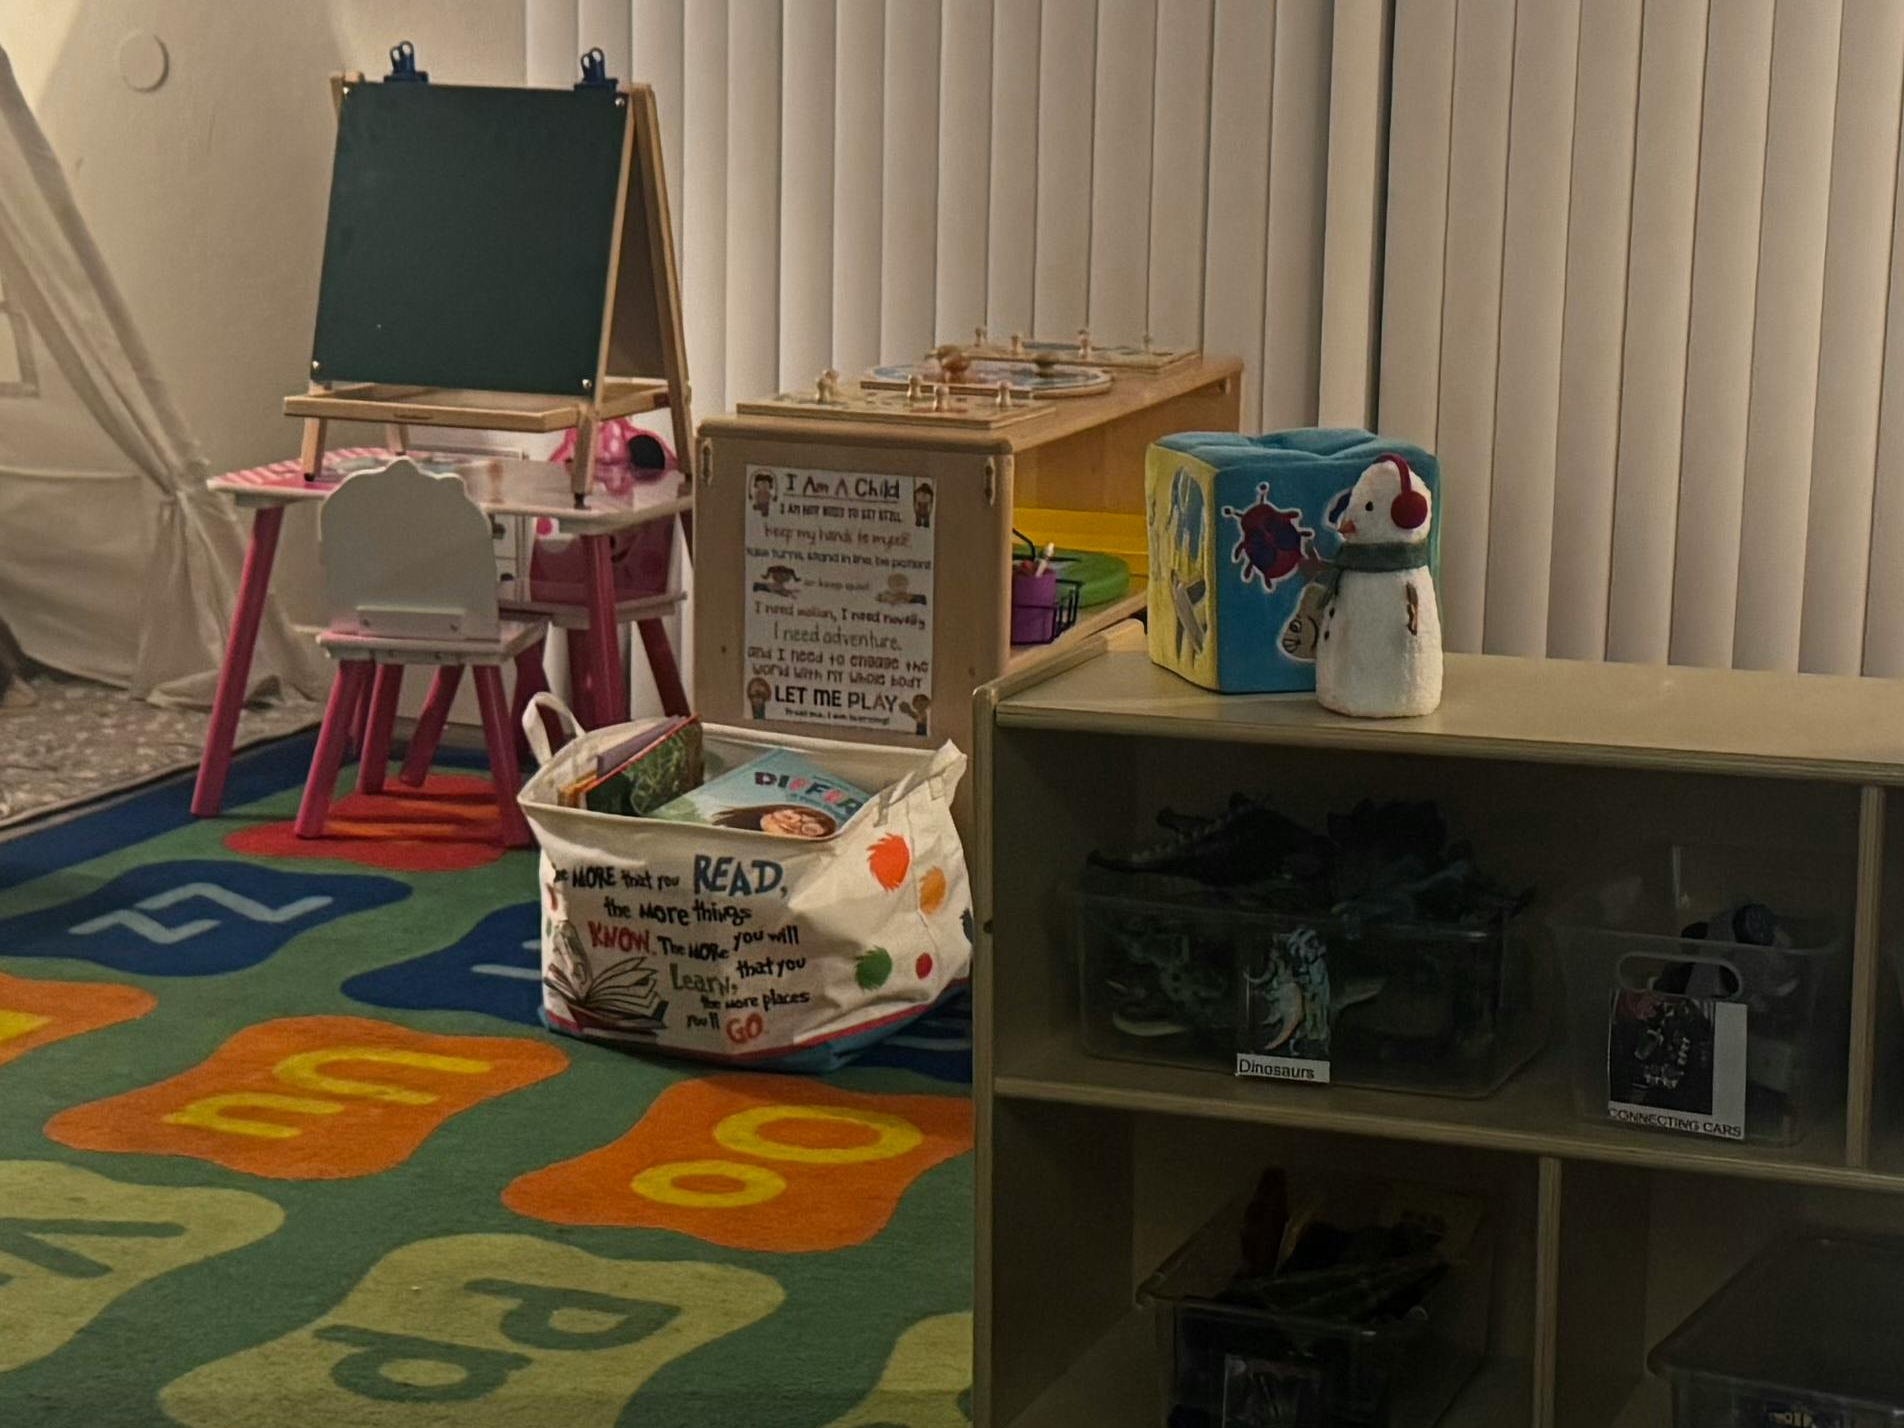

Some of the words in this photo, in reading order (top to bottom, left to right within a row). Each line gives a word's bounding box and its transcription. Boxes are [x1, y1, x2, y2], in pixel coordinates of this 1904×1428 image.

[786, 473, 795, 491] I
[802, 475, 829, 496] Am
[835, 477, 849, 497] A
[854, 476, 900, 500] Child
[851, 610, 880, 623] need
[783, 624, 820, 643] need
[774, 685, 808, 704] LET
[847, 692, 898, 713] PLAY
[620, 869, 653, 889] that
[657, 874, 680, 891] you
[693, 853, 789, 897] READ,
[603, 895, 633, 920] the
[693, 899, 752, 926] things
[734, 926, 765, 952] you
[767, 925, 800, 945] will
[736, 959, 772, 981] that
[775, 955, 807, 977] you
[761, 988, 810, 1011] places
[1238, 1058, 1315, 1081] Dinosaurs
[1702, 1122, 1742, 1139] CARS
